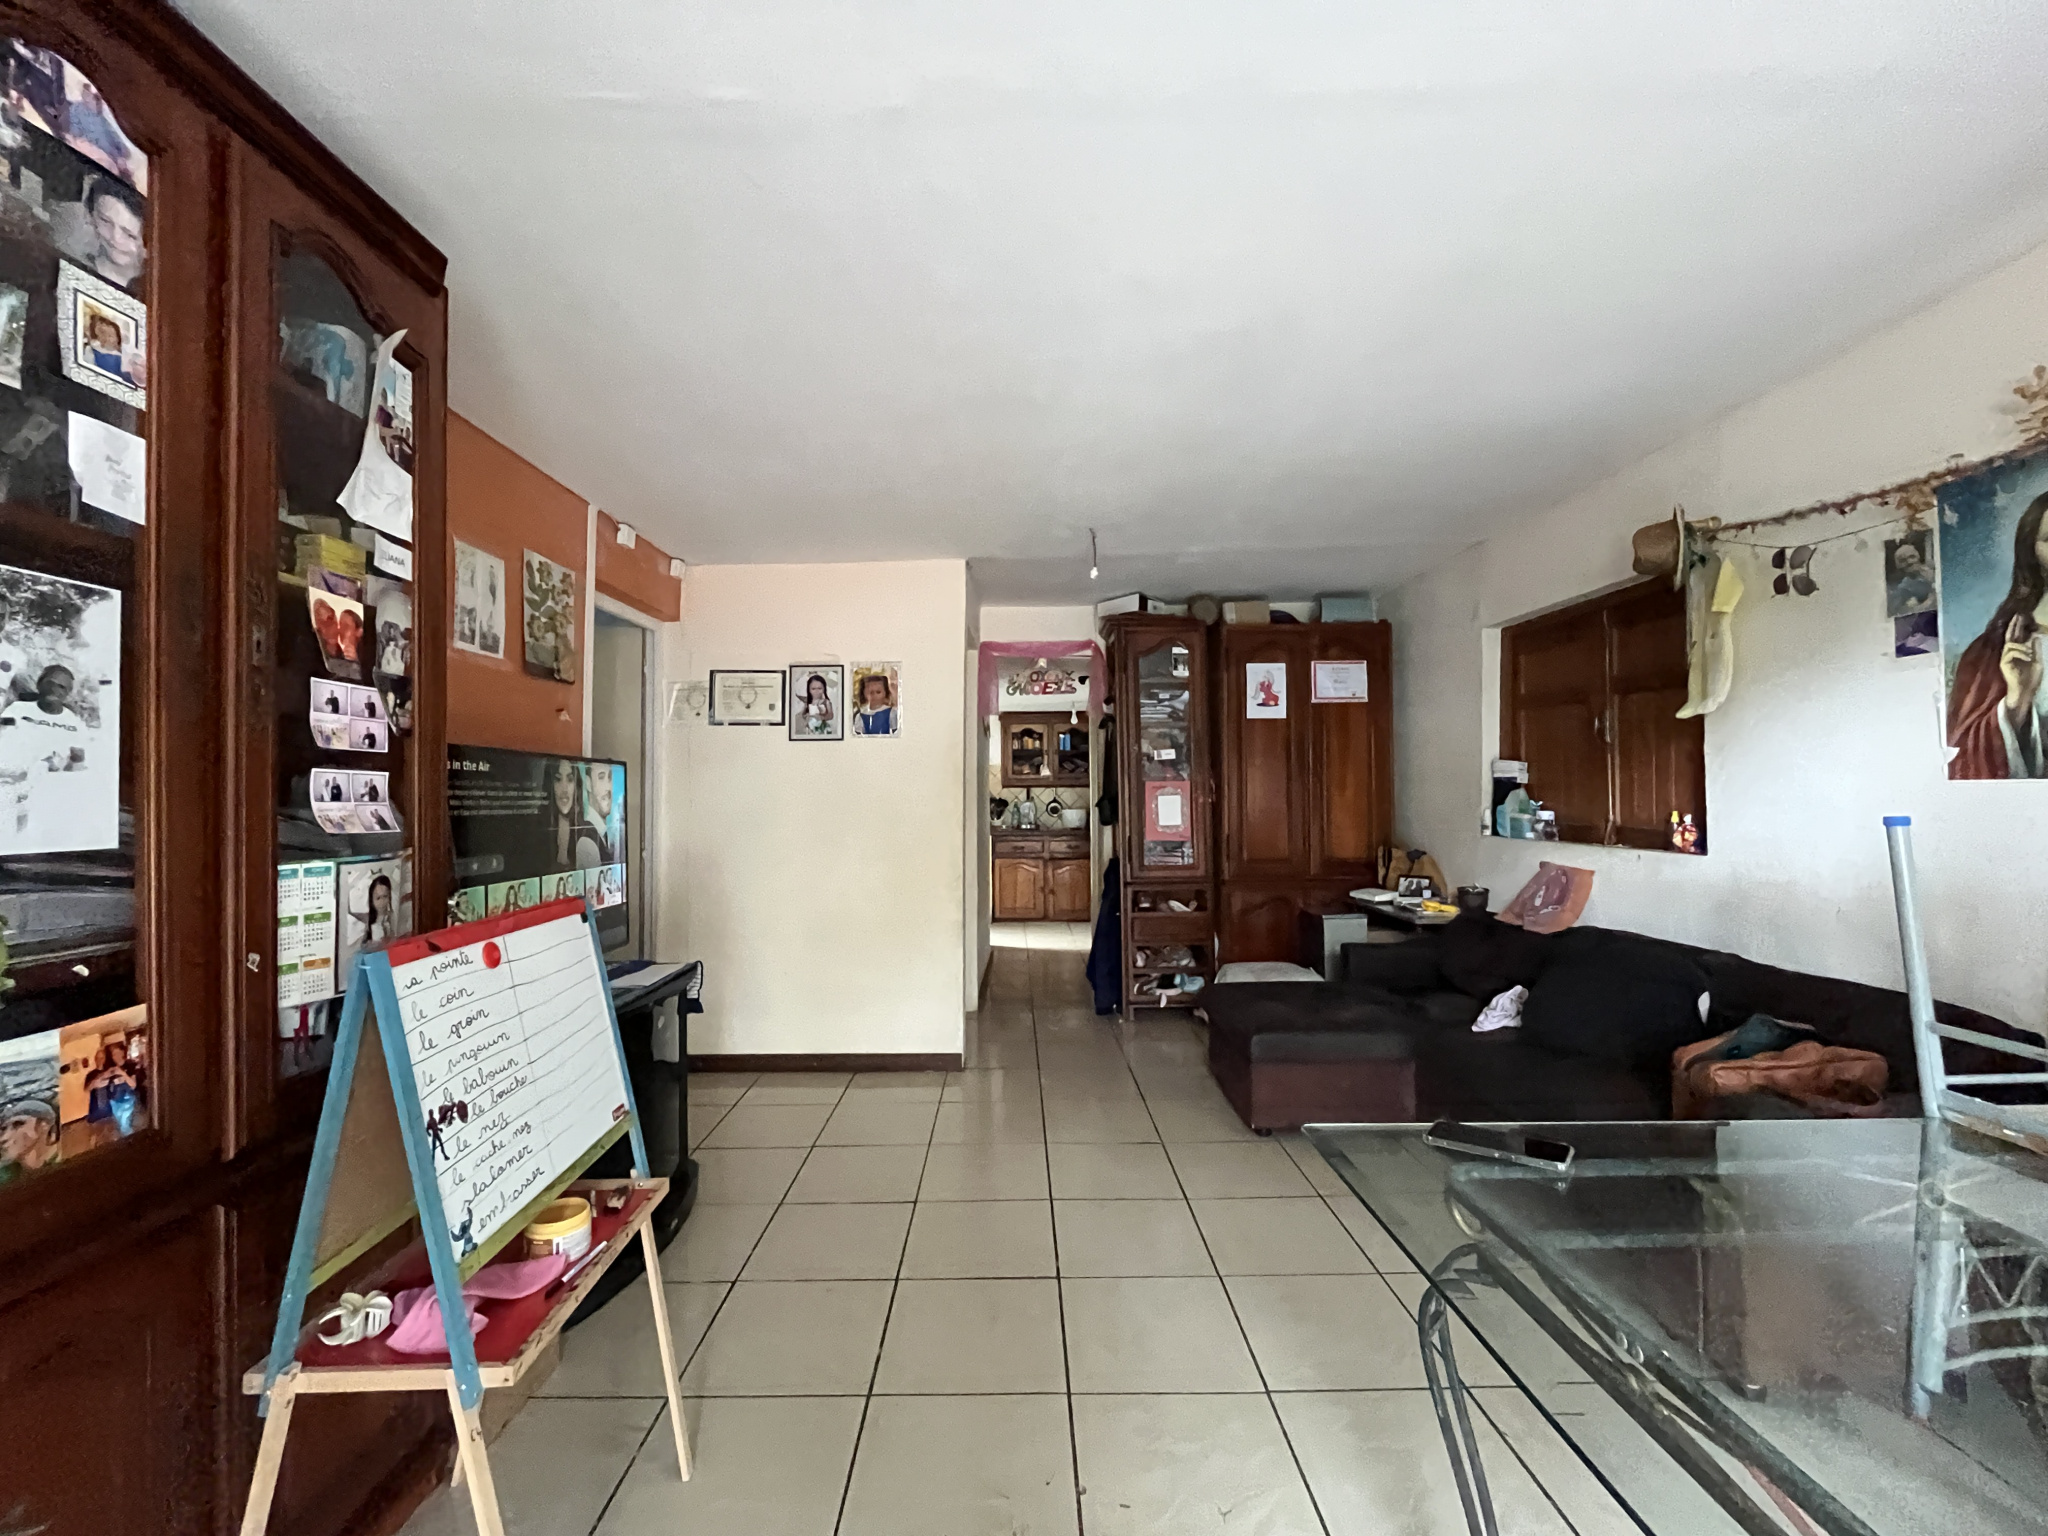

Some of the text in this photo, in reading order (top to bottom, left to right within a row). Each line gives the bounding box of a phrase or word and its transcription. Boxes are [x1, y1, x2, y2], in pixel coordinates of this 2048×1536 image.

[462, 760, 477, 771] the
[478, 760, 490, 772] Air
[430, 949, 474, 980] pointe
[411, 987, 474, 1022] le coin
[418, 1009, 489, 1055] le groin
[420, 1069, 437, 1092] le
[462, 1058, 519, 1095] babouin
[490, 1075, 527, 1107] bouche
[452, 1111, 511, 1160] le nez
[450, 1167, 466, 1190] le
